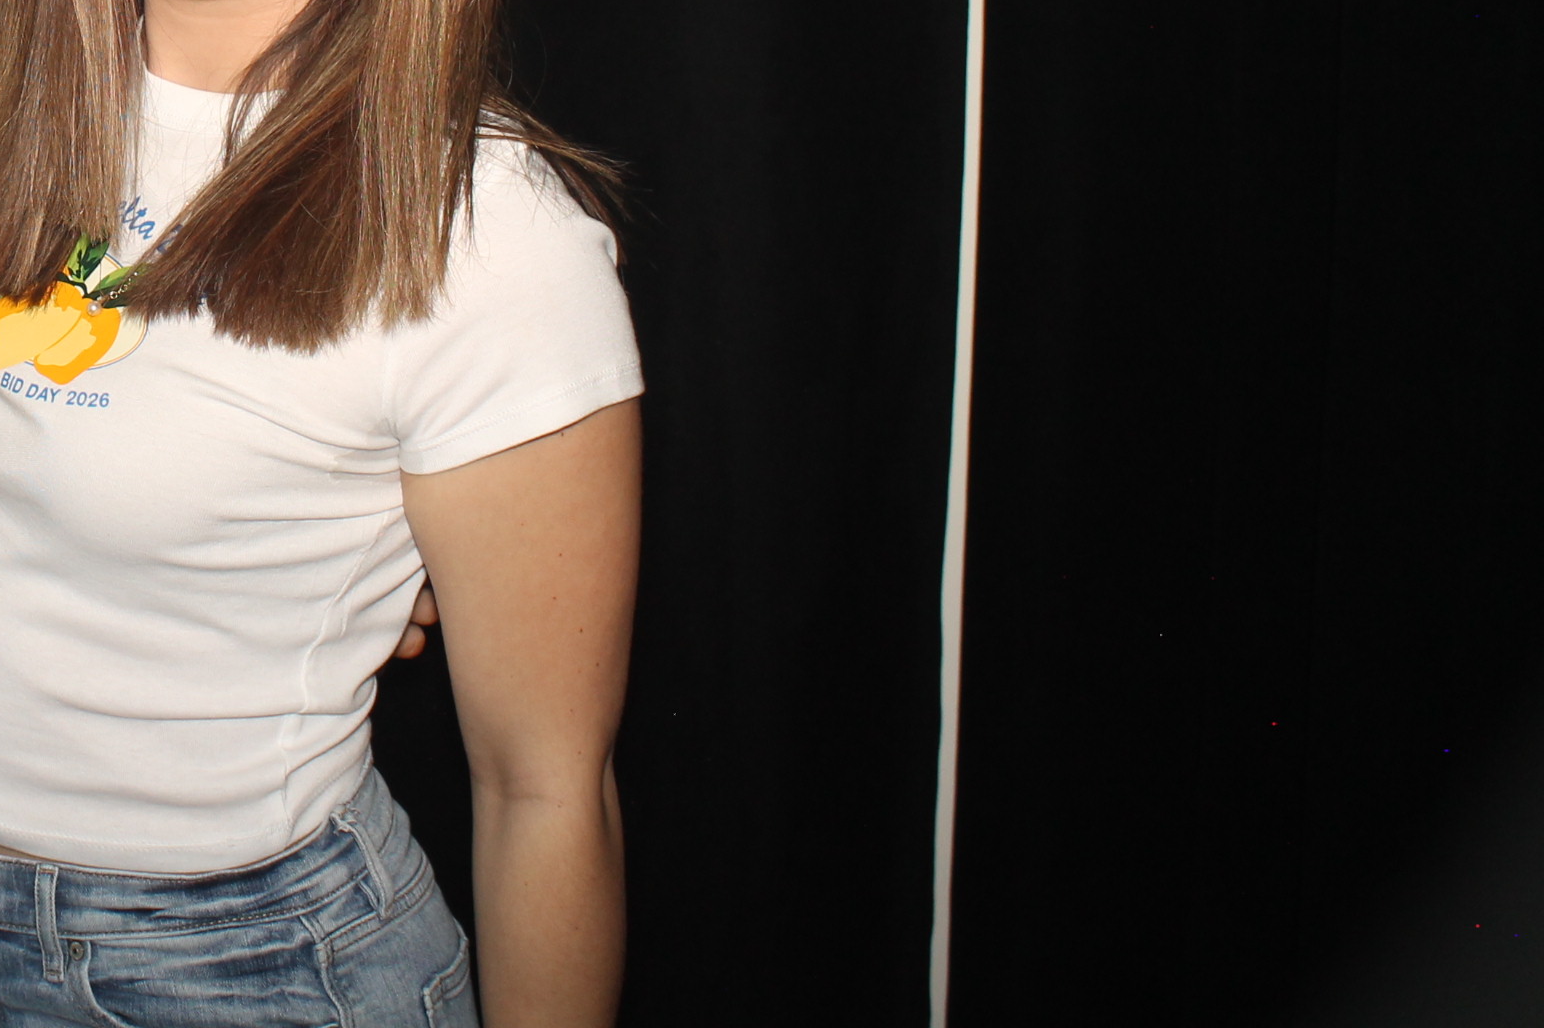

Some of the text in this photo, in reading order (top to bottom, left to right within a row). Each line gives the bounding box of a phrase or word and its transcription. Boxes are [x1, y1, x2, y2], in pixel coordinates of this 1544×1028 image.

[0, 371, 110, 408] BID DAY 2026
